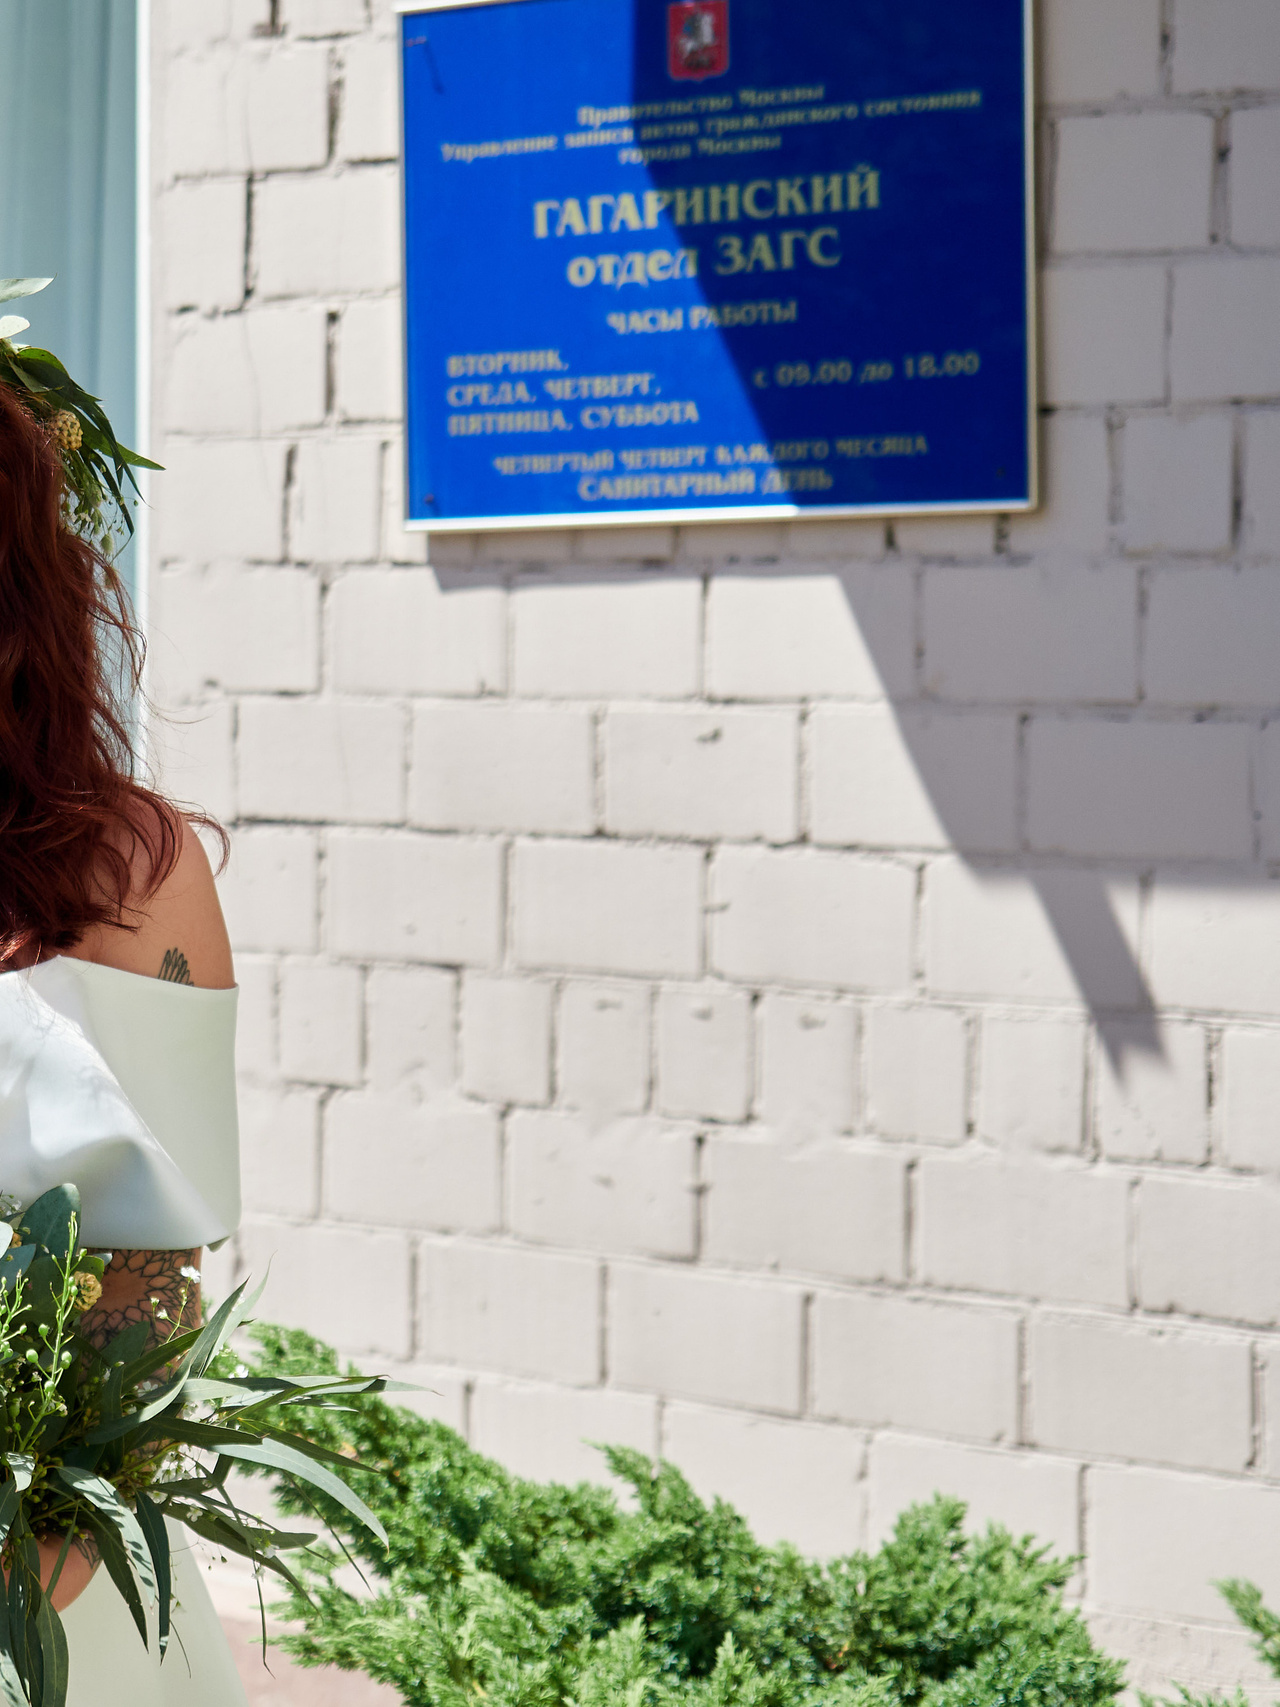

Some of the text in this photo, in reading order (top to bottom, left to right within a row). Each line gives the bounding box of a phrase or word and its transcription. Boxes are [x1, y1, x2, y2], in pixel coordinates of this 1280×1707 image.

[739, 86, 824, 106] Москвы
[442, 92, 981, 162] Управление записи актов гражданского состояния
[619, 137, 781, 164] города Москвы
[534, 165, 880, 237] ГАГАРИНСКИЙ
[567, 228, 841, 288] отдел ЗАГС
[607, 302, 797, 333] ЧАСЫ РАБОТЫ
[448, 352, 568, 376] ВТОРНИК,
[753, 352, 980, 387] с 09.00 до 18.00
[448, 374, 661, 405] СРЕДА, ЧЕТВЕРГ,
[448, 402, 699, 435] ПЯТНИЦА, СУББОТА
[494, 436, 927, 474] ЧЕТВЕРТЫЙ ЧЕТВЕРГ КАЖДОГО МЕСЯЦА
[578, 469, 833, 500] САНИТАРНЫЙ ДЕНЬ
